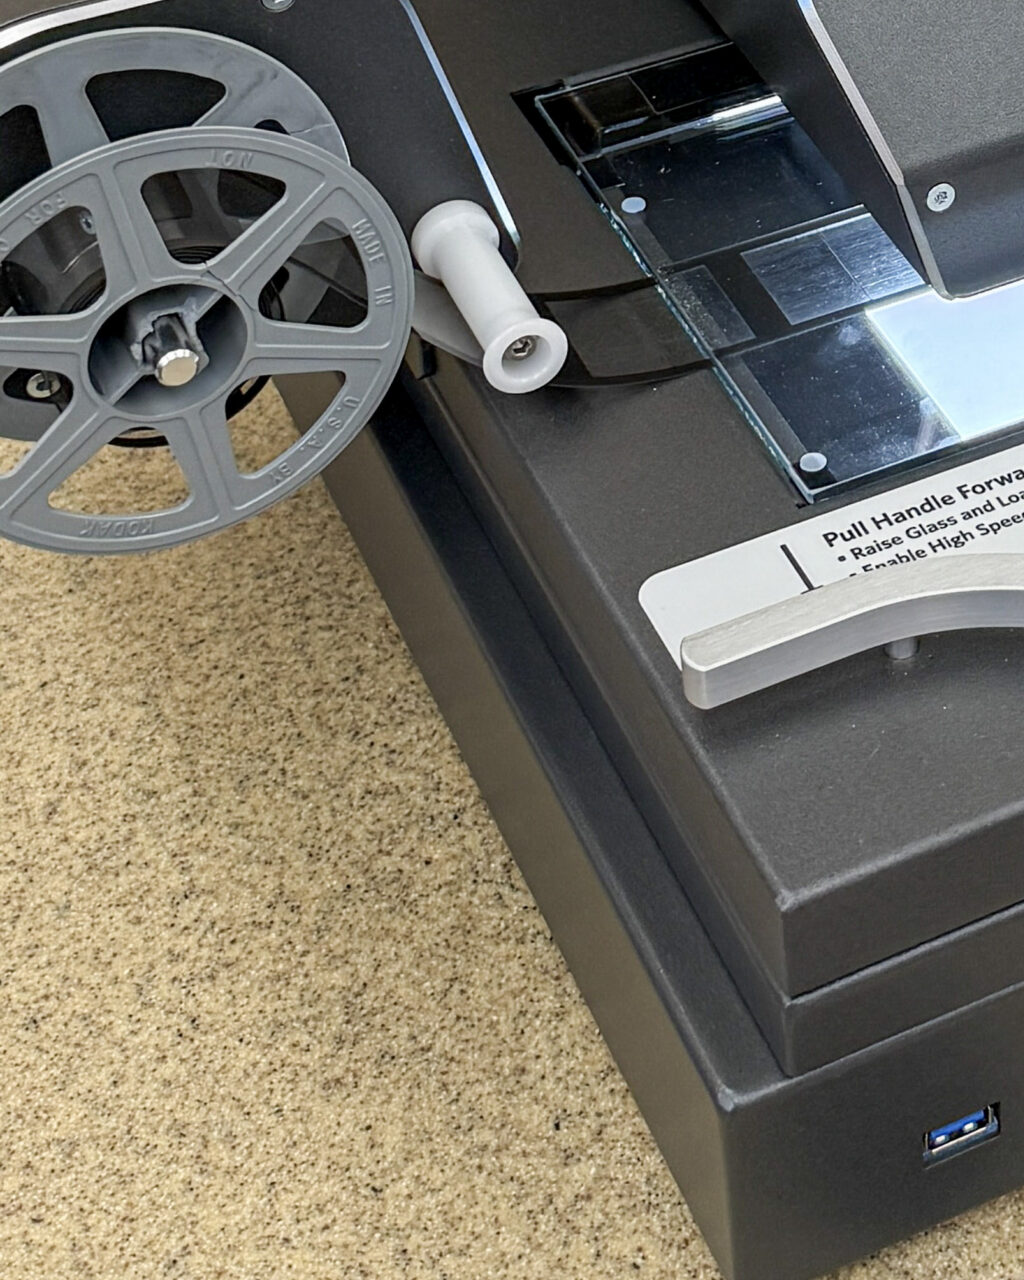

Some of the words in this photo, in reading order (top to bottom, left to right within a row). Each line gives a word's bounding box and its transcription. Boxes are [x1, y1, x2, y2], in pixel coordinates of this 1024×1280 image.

[373, 283, 392, 308] IN
[80, 518, 155, 538] KODAK
[822, 520, 869, 548] Pull
[872, 493, 955, 531] Handle
[850, 534, 904, 560] Raise
[905, 517, 958, 540] Glass
[961, 500, 995, 522] and
[932, 528, 976, 554] High
